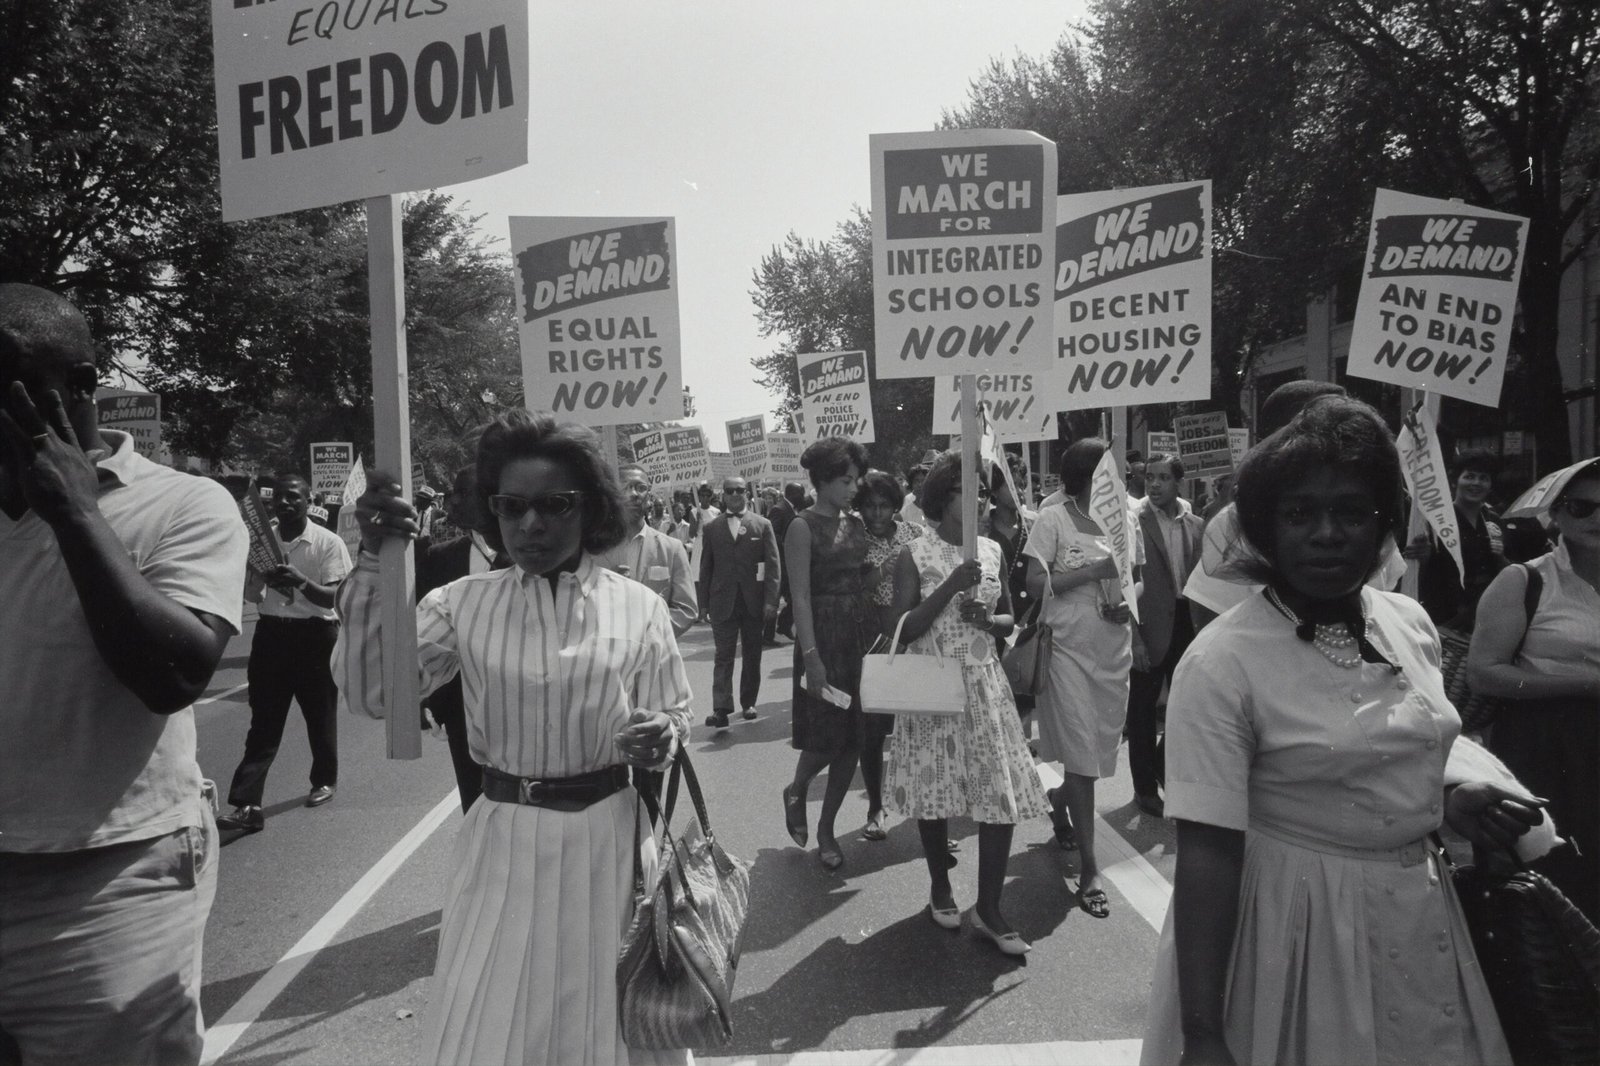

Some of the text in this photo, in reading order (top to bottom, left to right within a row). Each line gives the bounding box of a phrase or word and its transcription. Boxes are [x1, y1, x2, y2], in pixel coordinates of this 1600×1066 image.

[239, 24, 514, 160] FREEDOM
[941, 153, 988, 178] WE
[898, 180, 1031, 214] MARCH
[940, 216, 992, 232] FOR
[1094, 202, 1152, 246] WE
[1421, 217, 1477, 243] WE
[568, 232, 621, 269] WE
[887, 243, 1043, 276] INTEGRATED
[1055, 221, 1199, 292] DEMAND
[1379, 244, 1513, 272] DEMAND
[533, 254, 665, 310] DEMAND
[888, 282, 1041, 314] SCHOOLS
[1069, 289, 1190, 323] DECENT
[1379, 283, 1502, 326] AN END
[548, 316, 658, 342] EQUAL
[900, 315, 1034, 361] NOW!
[1058, 323, 1201, 358] HOUSING
[1379, 310, 1496, 353] TO BIAS
[548, 346, 663, 373] RIGHTS
[822, 356, 845, 374] WE
[1067, 348, 1194, 394] NOW!
[1374, 340, 1492, 385] NOW!
[552, 371, 667, 412] NOW!
[807, 365, 862, 394] DEMAND
[953, 374, 1033, 392] RGHTS
[116, 396, 139, 408] WE
[812, 392, 860, 404] AN END
[824, 405, 853, 415] POLICE
[101, 406, 156, 422] DEMAND
[816, 413, 860, 424] BRUTALITY
[645, 434, 660, 446] WE
[733, 427, 760, 441] MARCH
[817, 419, 867, 439] NOW!
[1180, 426, 1210, 440] JOBS
[638, 442, 662, 459] DEMA
[669, 436, 700, 448] MARCH
[733, 444, 766, 458] FIRST CLASS
[1180, 438, 1228, 454] FREEDOM
[669, 449, 705, 462] INTEGRATED
[670, 459, 708, 471] SCHOOLS
[733, 452, 767, 466] CITIZENSHIP
[771, 464, 799, 472] REEDOM
[676, 466, 707, 481] NOW!
[740, 462, 767, 478] NOW!
[1402, 422, 1445, 512] FREEDOM
[1435, 513, 1445, 525] IN
[316, 480, 348, 489] NOW!
[242, 495, 261, 528] MARCH
[1092, 468, 1127, 557] FREEDOM
